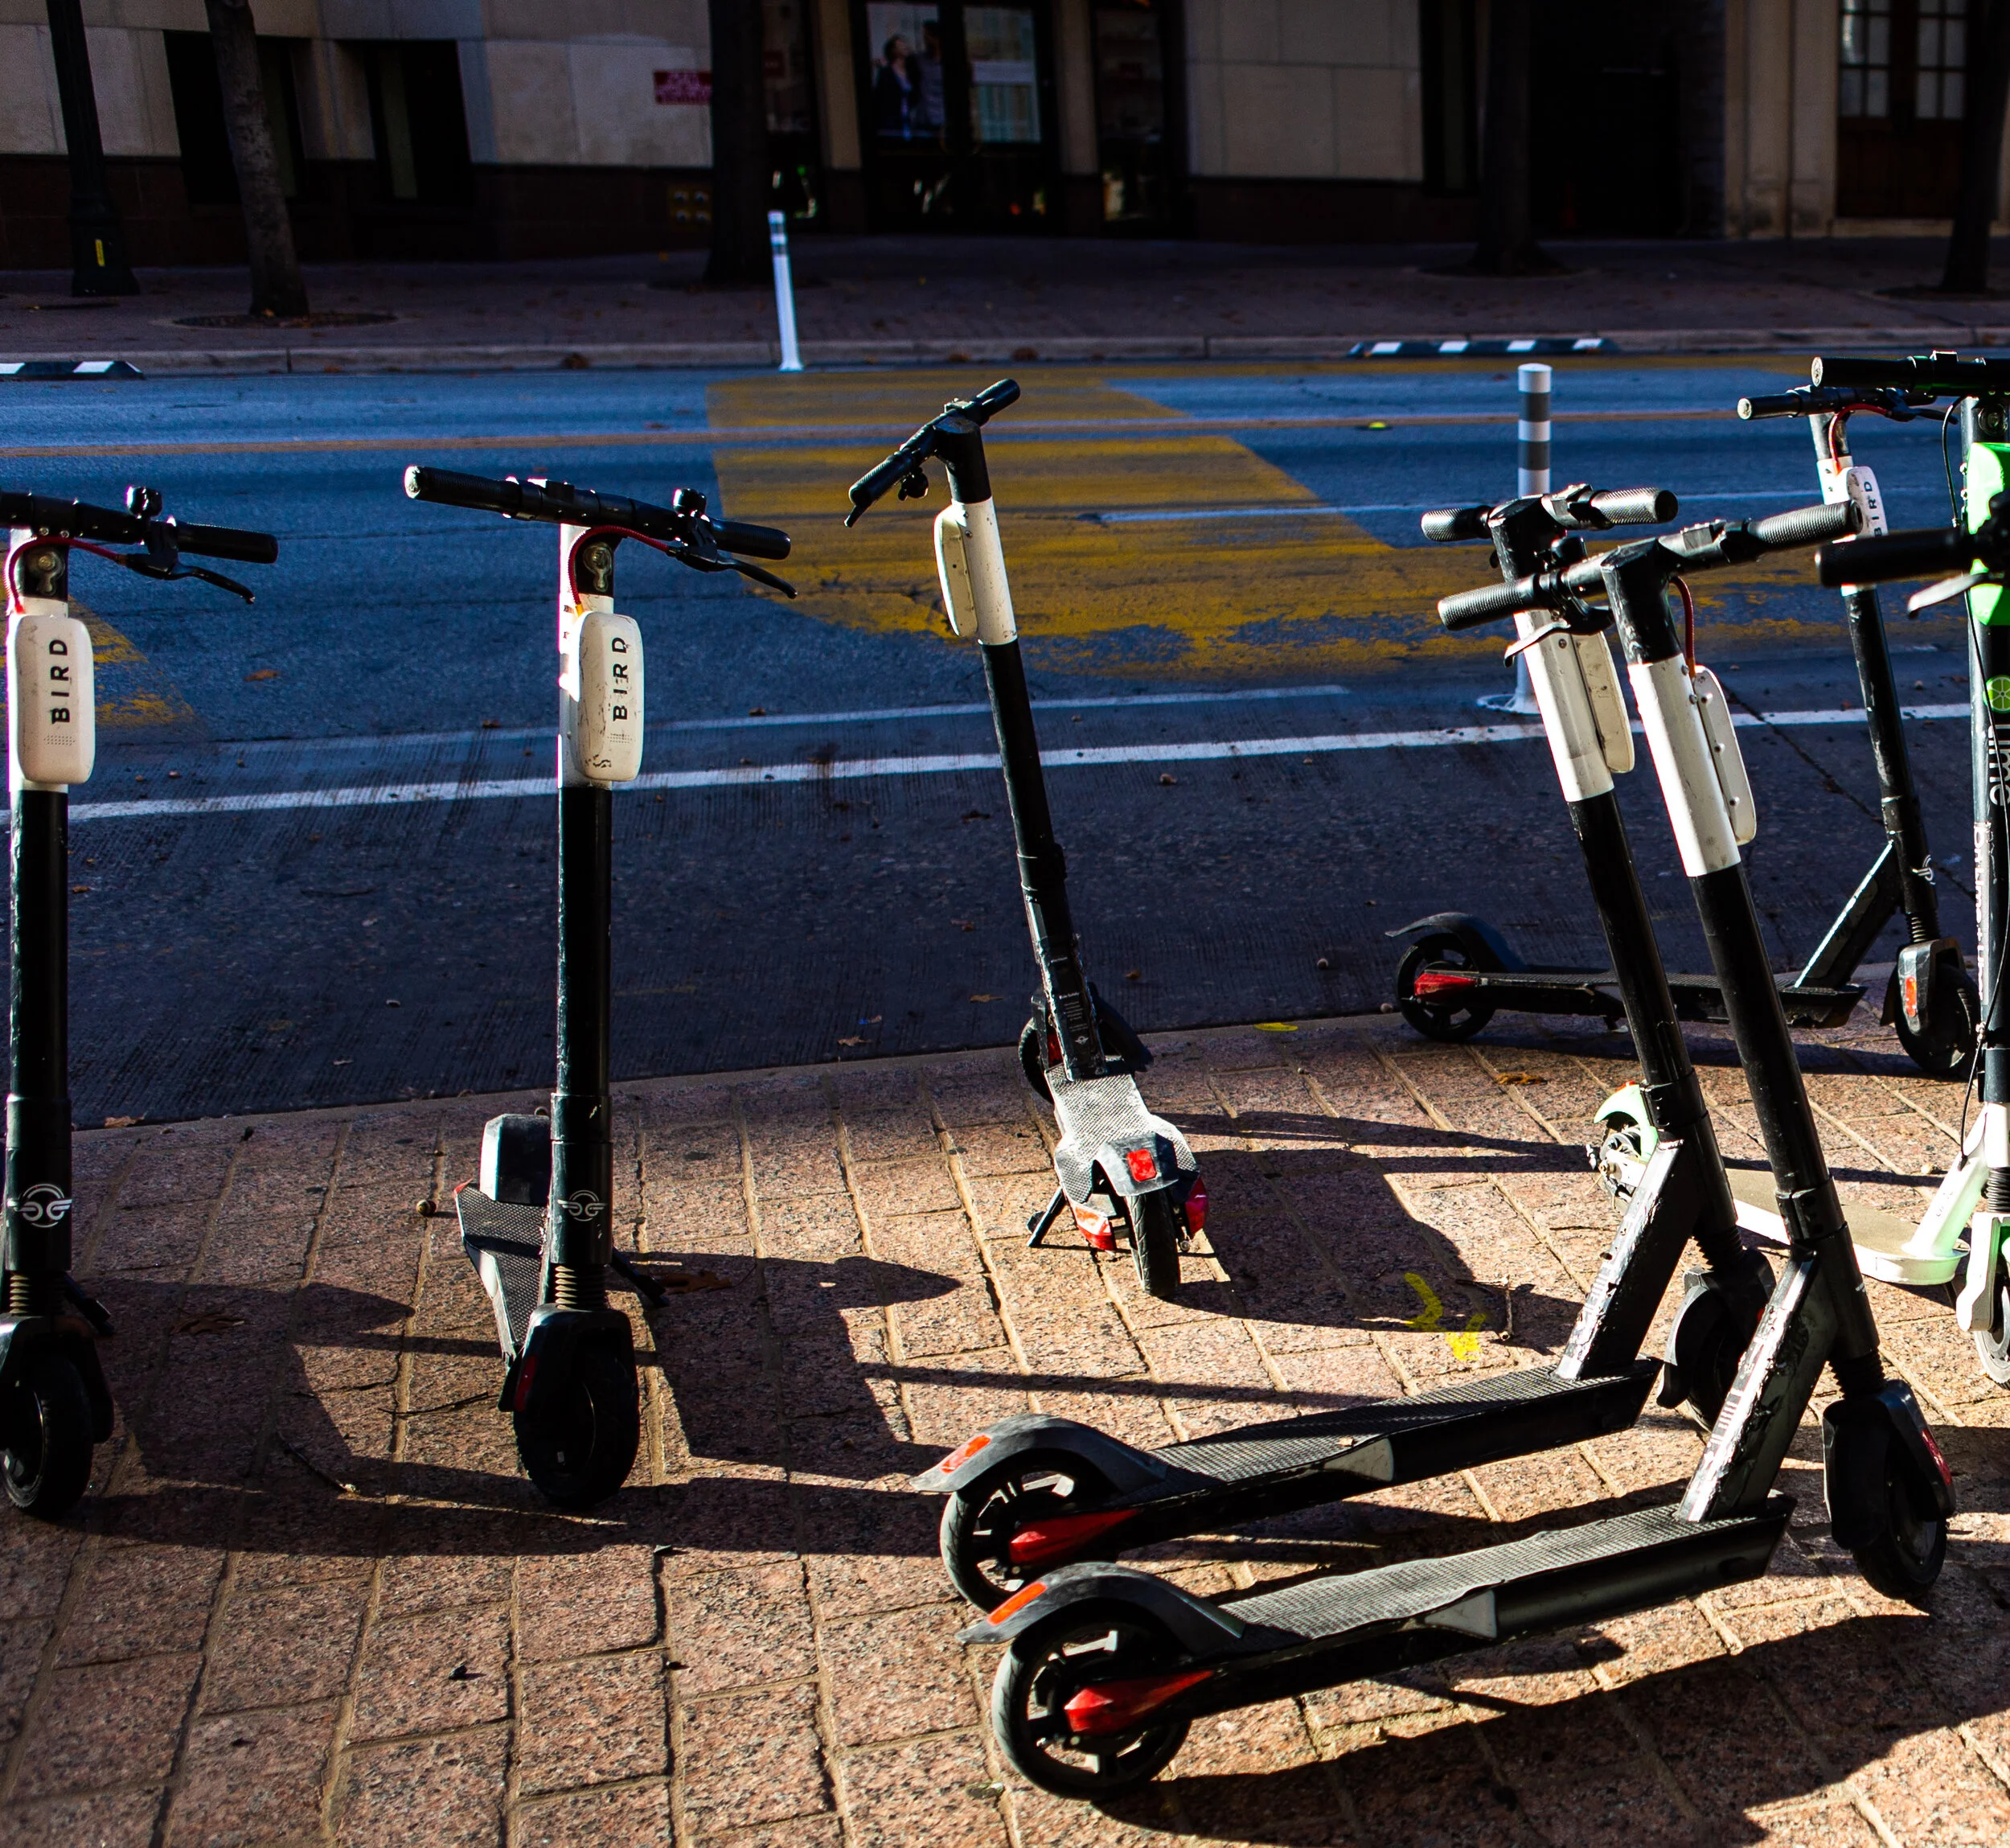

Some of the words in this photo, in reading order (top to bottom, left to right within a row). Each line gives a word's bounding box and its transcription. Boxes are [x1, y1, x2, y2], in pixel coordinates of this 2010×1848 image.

[1864, 481, 1882, 537] BIRD
[48, 639, 70, 725] BIRD
[611, 637, 629, 721] BIRD
